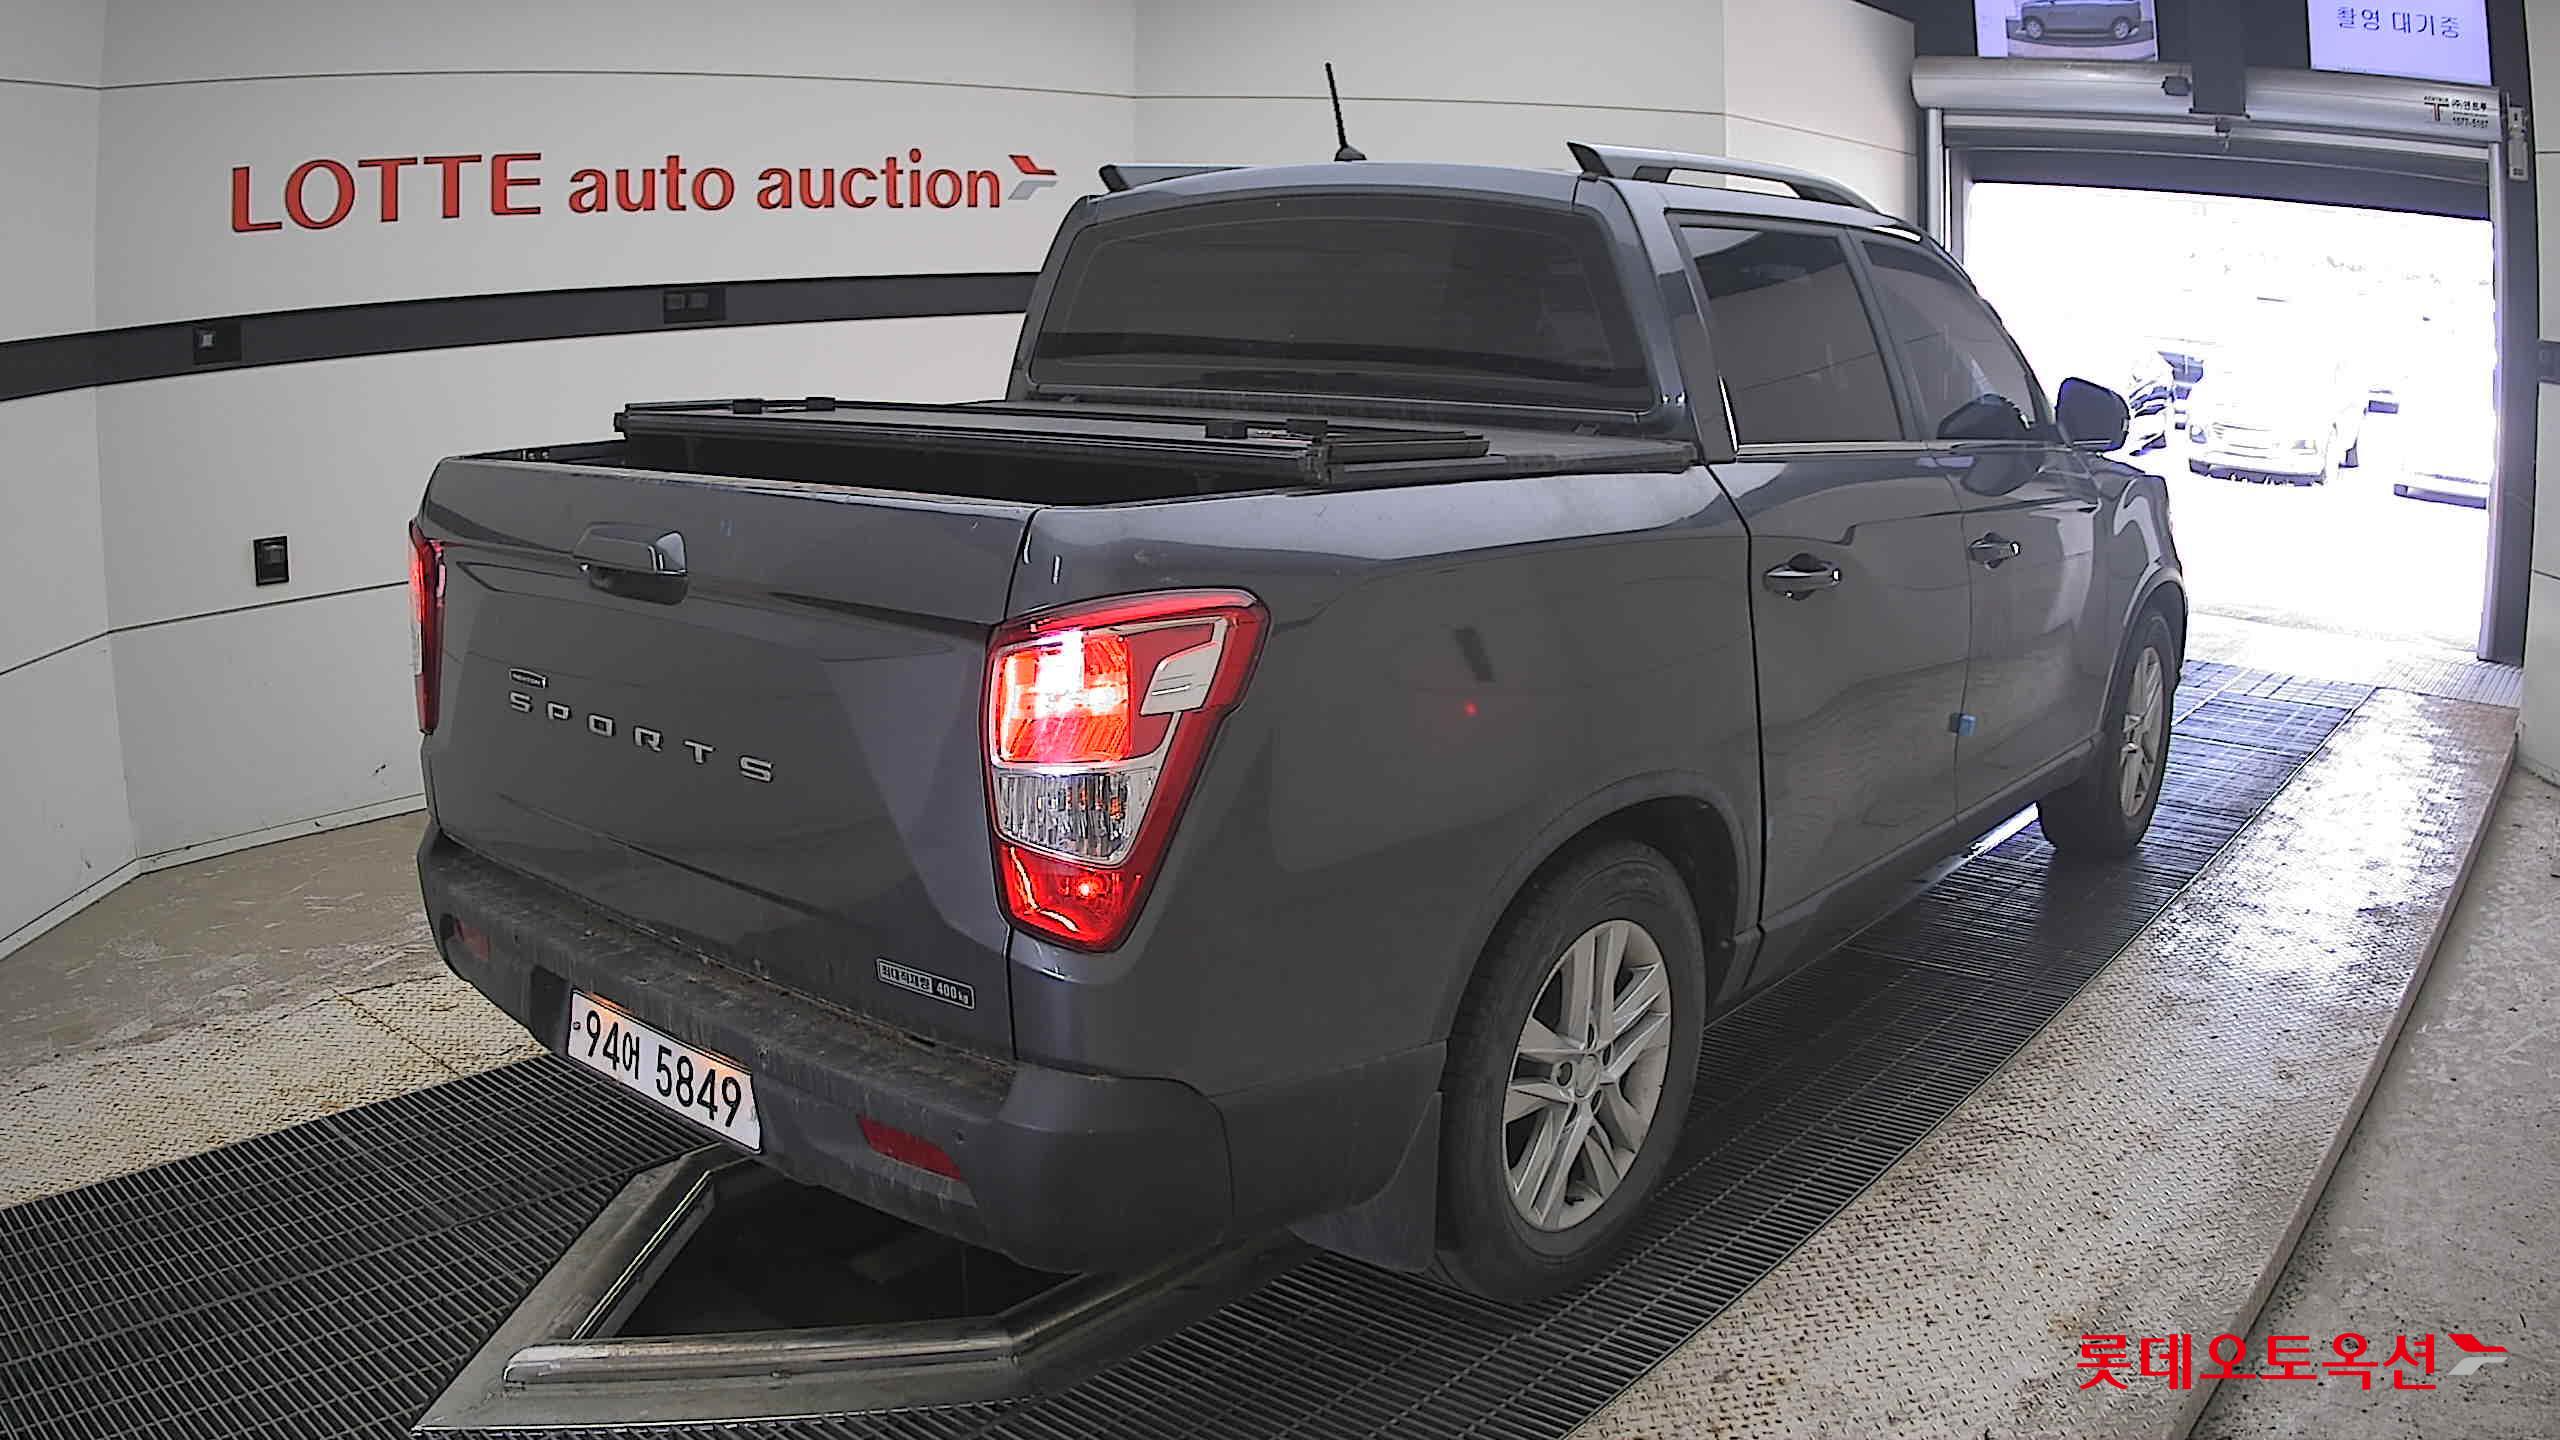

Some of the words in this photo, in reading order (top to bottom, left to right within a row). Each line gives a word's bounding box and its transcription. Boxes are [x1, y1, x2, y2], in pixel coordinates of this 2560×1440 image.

[2337, 6, 2381, 32] 촬영
[2392, 11, 2460, 39] 대기중
[232, 153, 541, 232] LOTTE
[568, 155, 735, 213] auto
[756, 148, 1000, 209] auction
[509, 690, 773, 783] SPORTS
[586, 1010, 640, 1081] 94어
[656, 1044, 742, 1128] 5849
